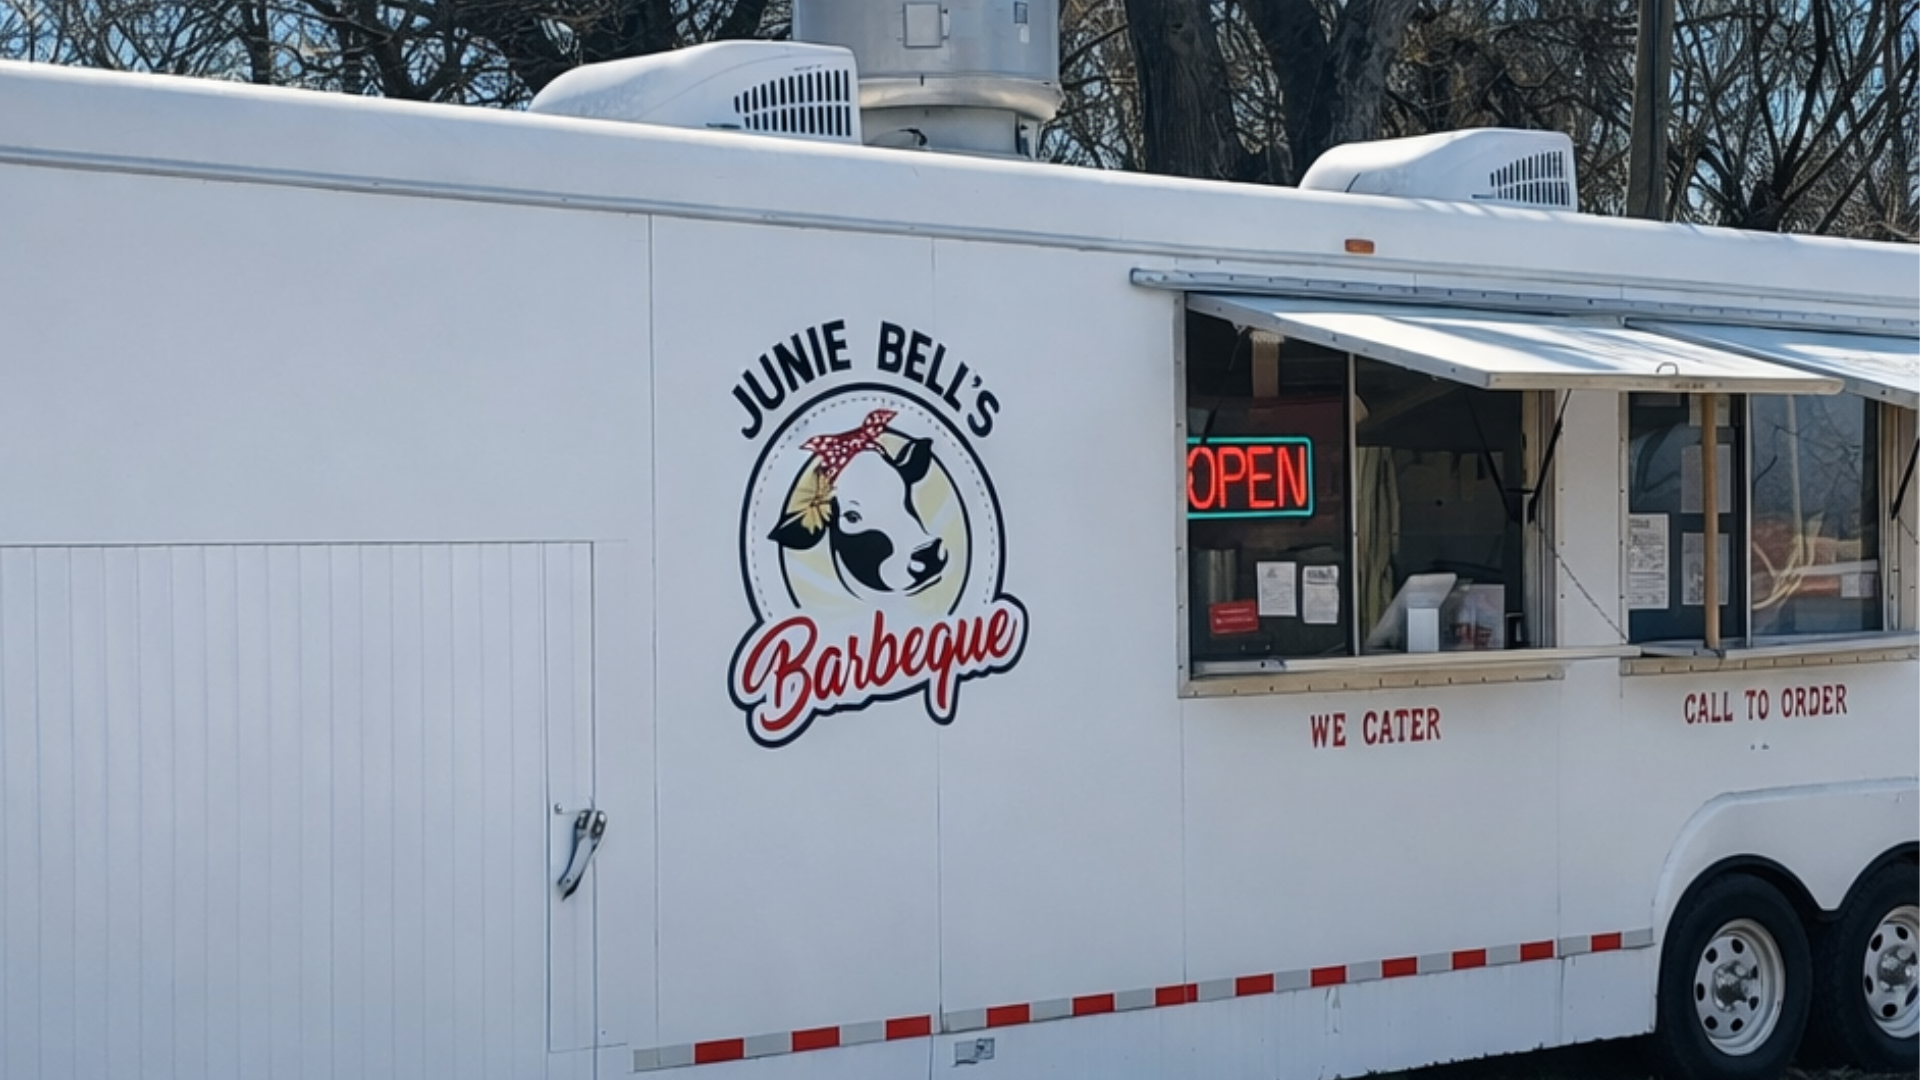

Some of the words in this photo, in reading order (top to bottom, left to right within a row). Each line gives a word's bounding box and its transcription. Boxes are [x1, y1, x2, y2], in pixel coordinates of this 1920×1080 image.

[732, 320, 852, 438] JUNIE
[1187, 446, 1306, 509] OPEN
[743, 609, 1017, 732] Barbeque
[1310, 713, 1346, 749] WE
[1362, 707, 1441, 746] CATER
[1684, 690, 1733, 724] CALL
[1745, 688, 1770, 721] TO
[1781, 684, 1848, 718] ORDER
